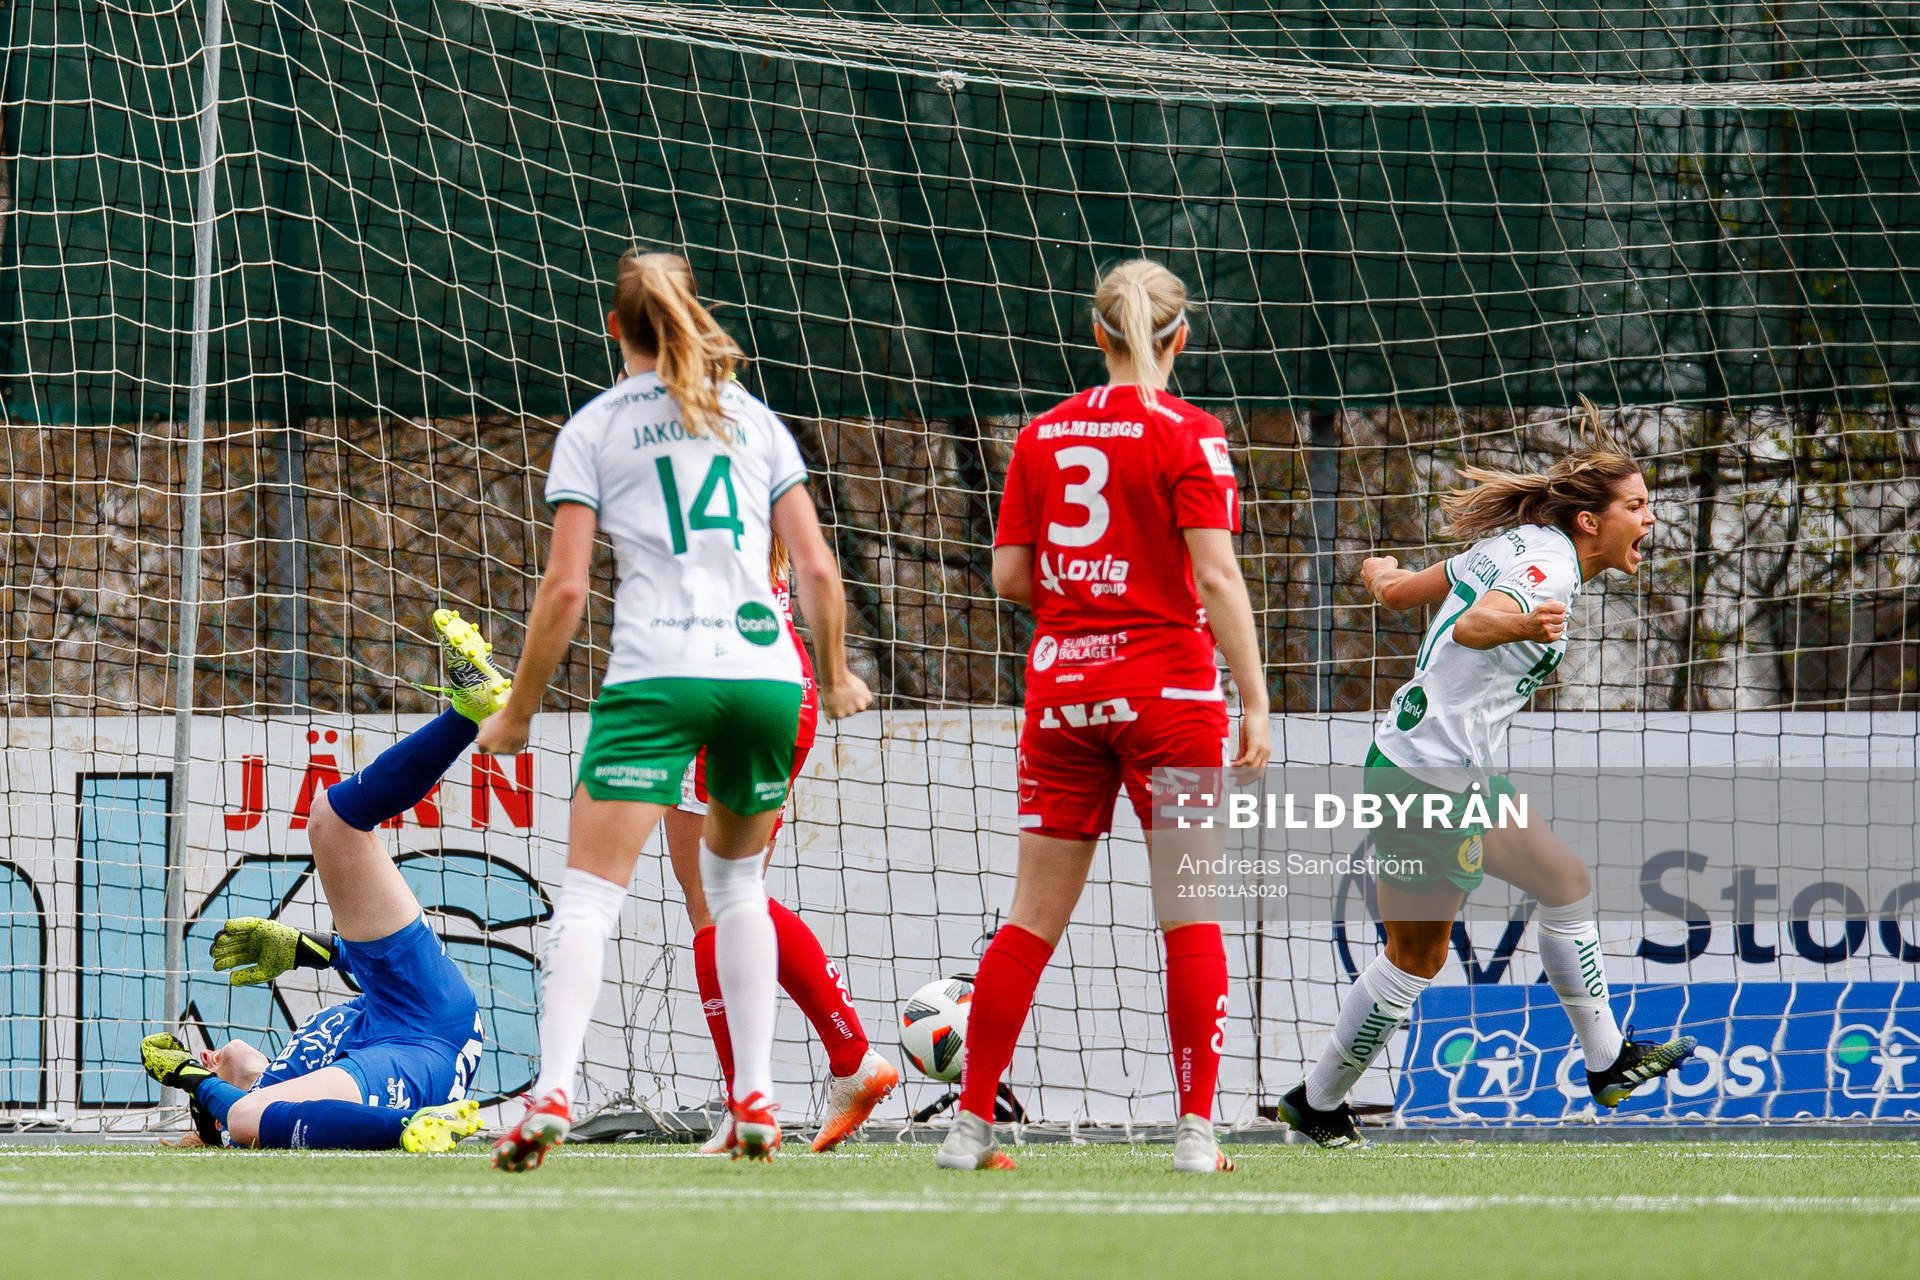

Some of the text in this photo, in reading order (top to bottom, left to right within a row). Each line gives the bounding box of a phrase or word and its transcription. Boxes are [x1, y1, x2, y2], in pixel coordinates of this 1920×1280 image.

[632, 420, 748, 450] JAKOON
[1036, 420, 1144, 440] MALMBERGS
[654, 454, 745, 555] 14
[1047, 445, 1110, 547] 3
[1057, 552, 1130, 582] Loxia
[1090, 582, 1128, 597] group
[737, 614, 778, 633] bank
[1058, 646, 1117, 660] BOLAGET
[1402, 694, 1423, 719] bank
[830, 1011, 853, 1040] umbro
[1182, 1046, 1193, 1092] umbro
